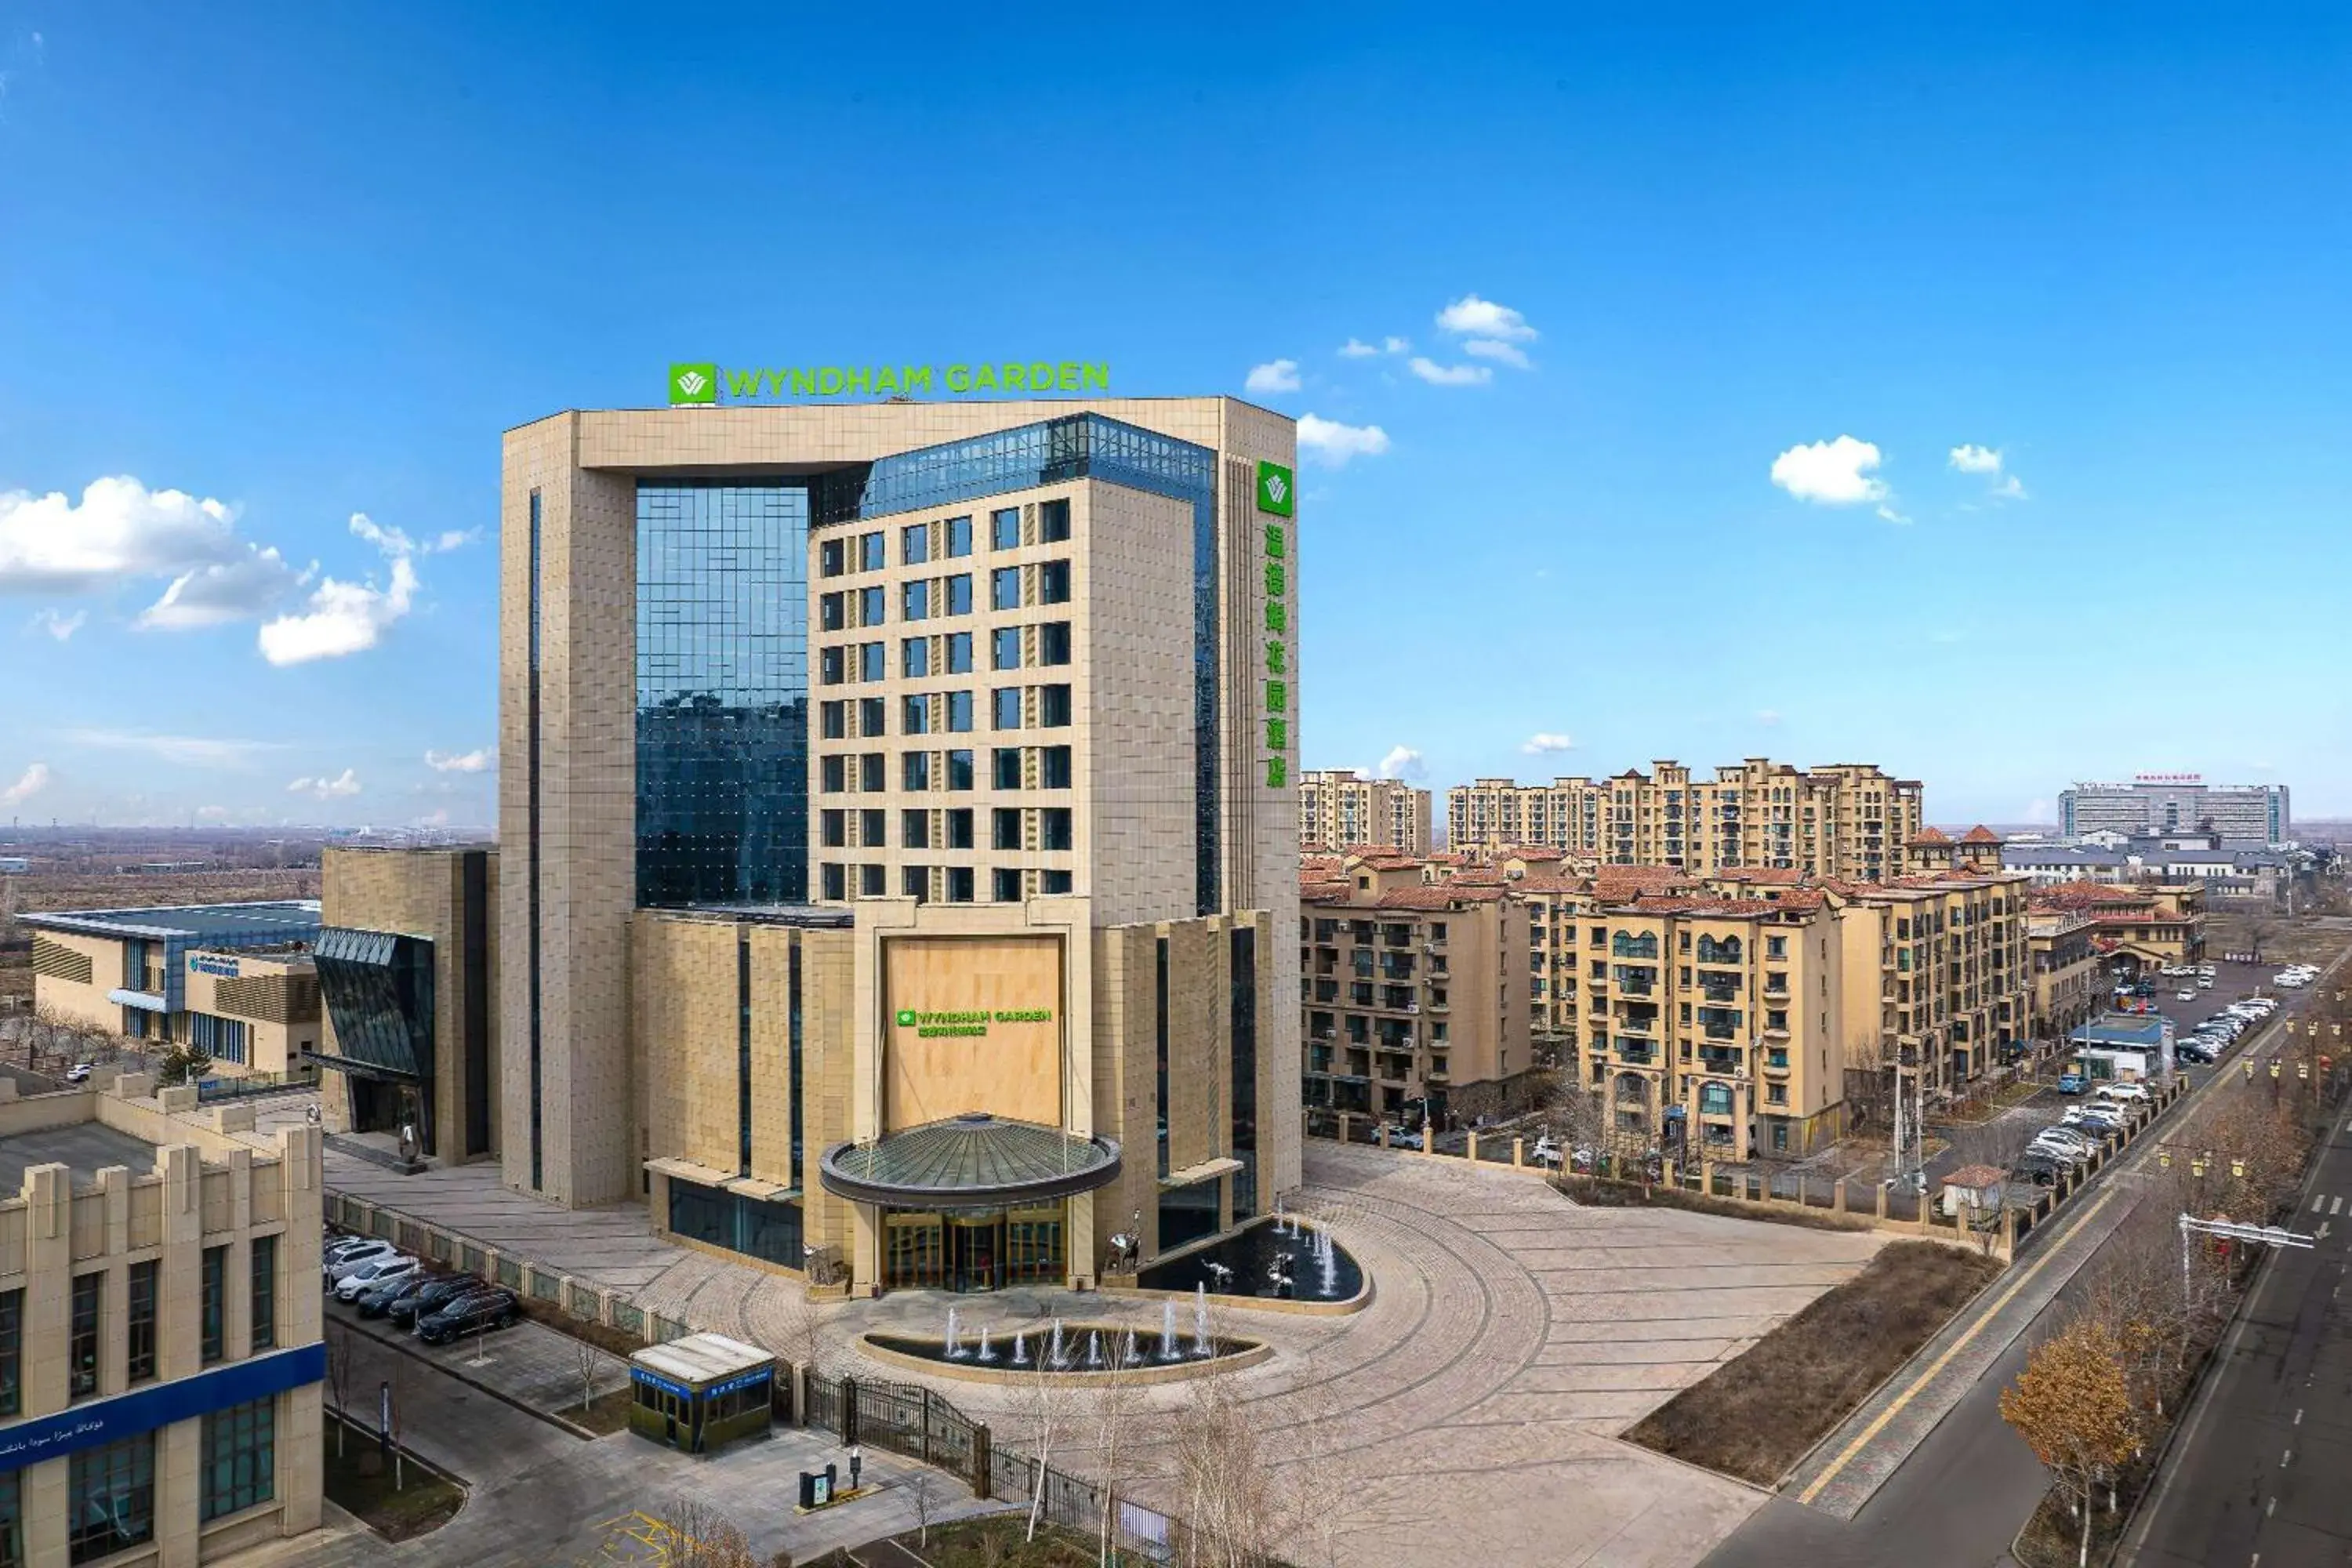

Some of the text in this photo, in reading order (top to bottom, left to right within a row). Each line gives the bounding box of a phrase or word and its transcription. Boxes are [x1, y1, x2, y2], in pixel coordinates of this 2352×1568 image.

[725, 362, 1109, 397] WYNDHAM GARDEN
[918, 1010, 1051, 1024] WYNDHAM GARDEN
